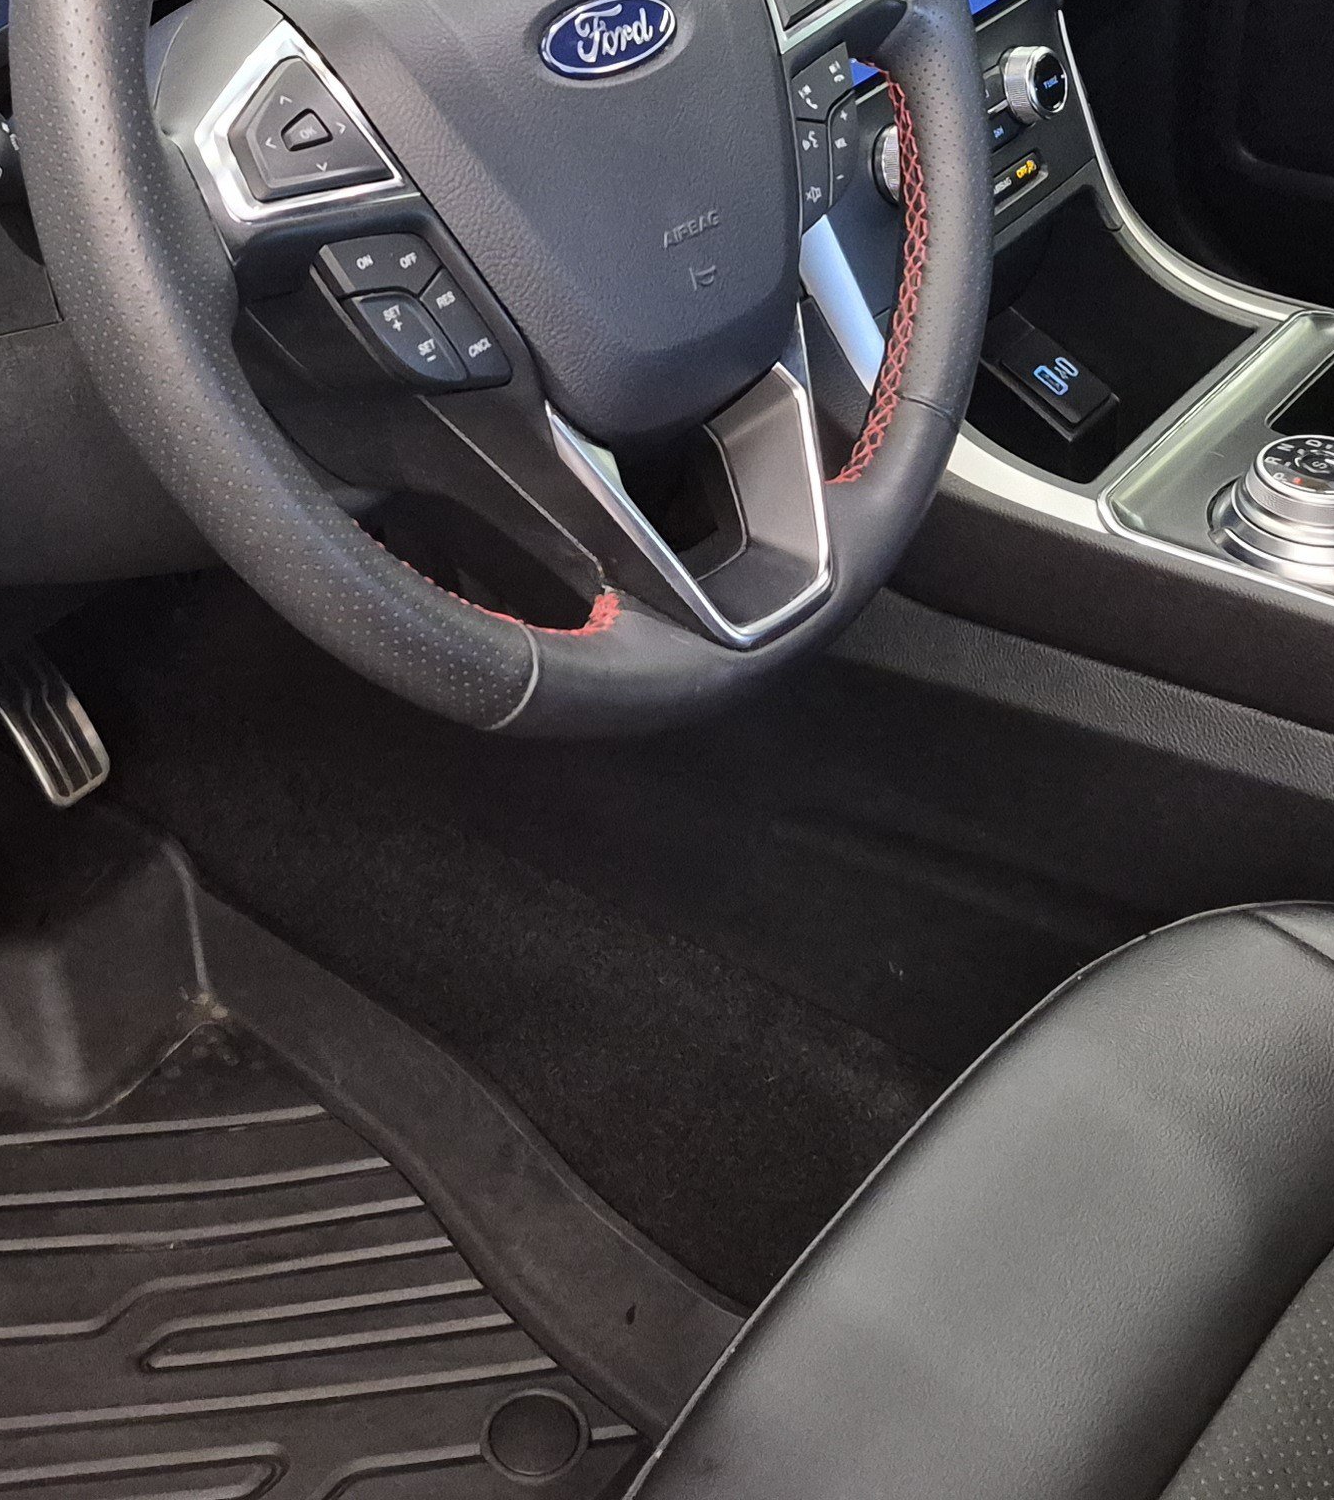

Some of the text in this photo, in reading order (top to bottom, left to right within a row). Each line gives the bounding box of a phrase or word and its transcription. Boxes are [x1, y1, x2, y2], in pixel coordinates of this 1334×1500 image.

[574, 3, 653, 63] Ford
[299, 126, 318, 140] OK
[662, 209, 721, 249] AIRBAG
[356, 252, 417, 270] ON OFF
[436, 291, 456, 309] RES
[382, 304, 401, 322] SET
[418, 338, 436, 357] SET
[468, 337, 492, 358] CNCL
[1277, 442, 1295, 452] N
[1305, 438, 1322, 447] D
[1264, 456, 1282, 465] R
